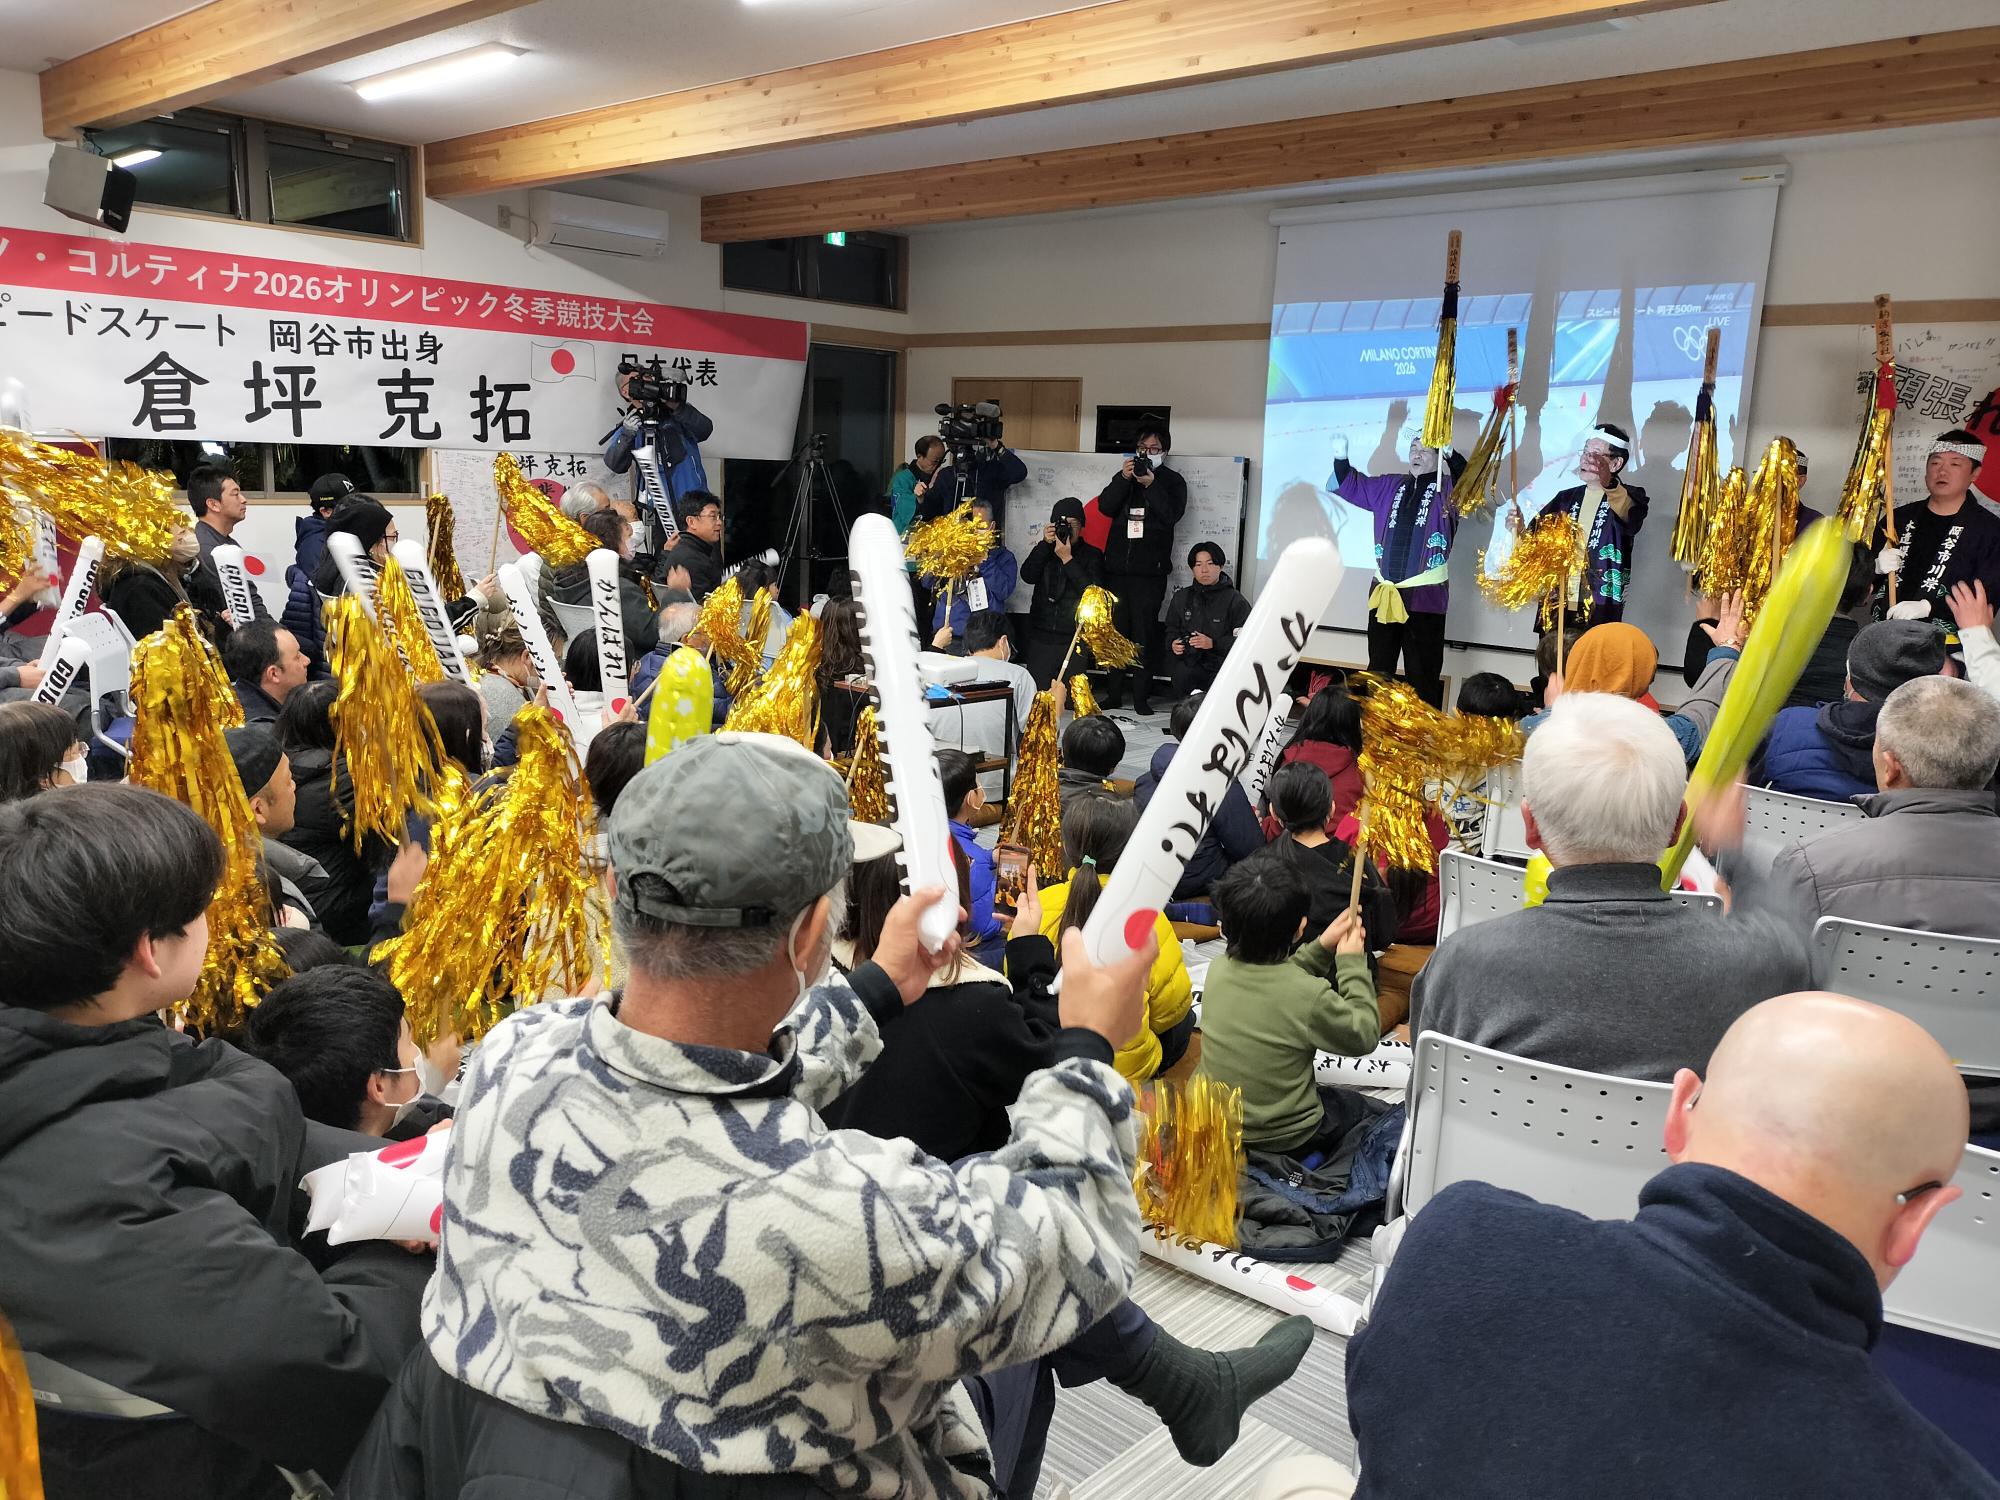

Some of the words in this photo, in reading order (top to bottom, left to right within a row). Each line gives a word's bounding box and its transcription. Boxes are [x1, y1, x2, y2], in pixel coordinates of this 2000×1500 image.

[1585, 305, 1656, 318] スピードート
[1708, 316, 1731, 326] LIVE
[269, 319, 444, 365] 岡谷市出身
[1359, 347, 1400, 362] MILANO
[1401, 345, 1438, 361] CORTIN
[1393, 361, 1416, 375] 2026
[518, 453, 588, 478] 坪克拓
[1415, 482, 1437, 528] 岡谷市川岸
[1588, 501, 1611, 550] 岡谷市川岸
[1920, 525, 1965, 593] 岡谷市川岸
[596, 578, 628, 681] がんばれ!
